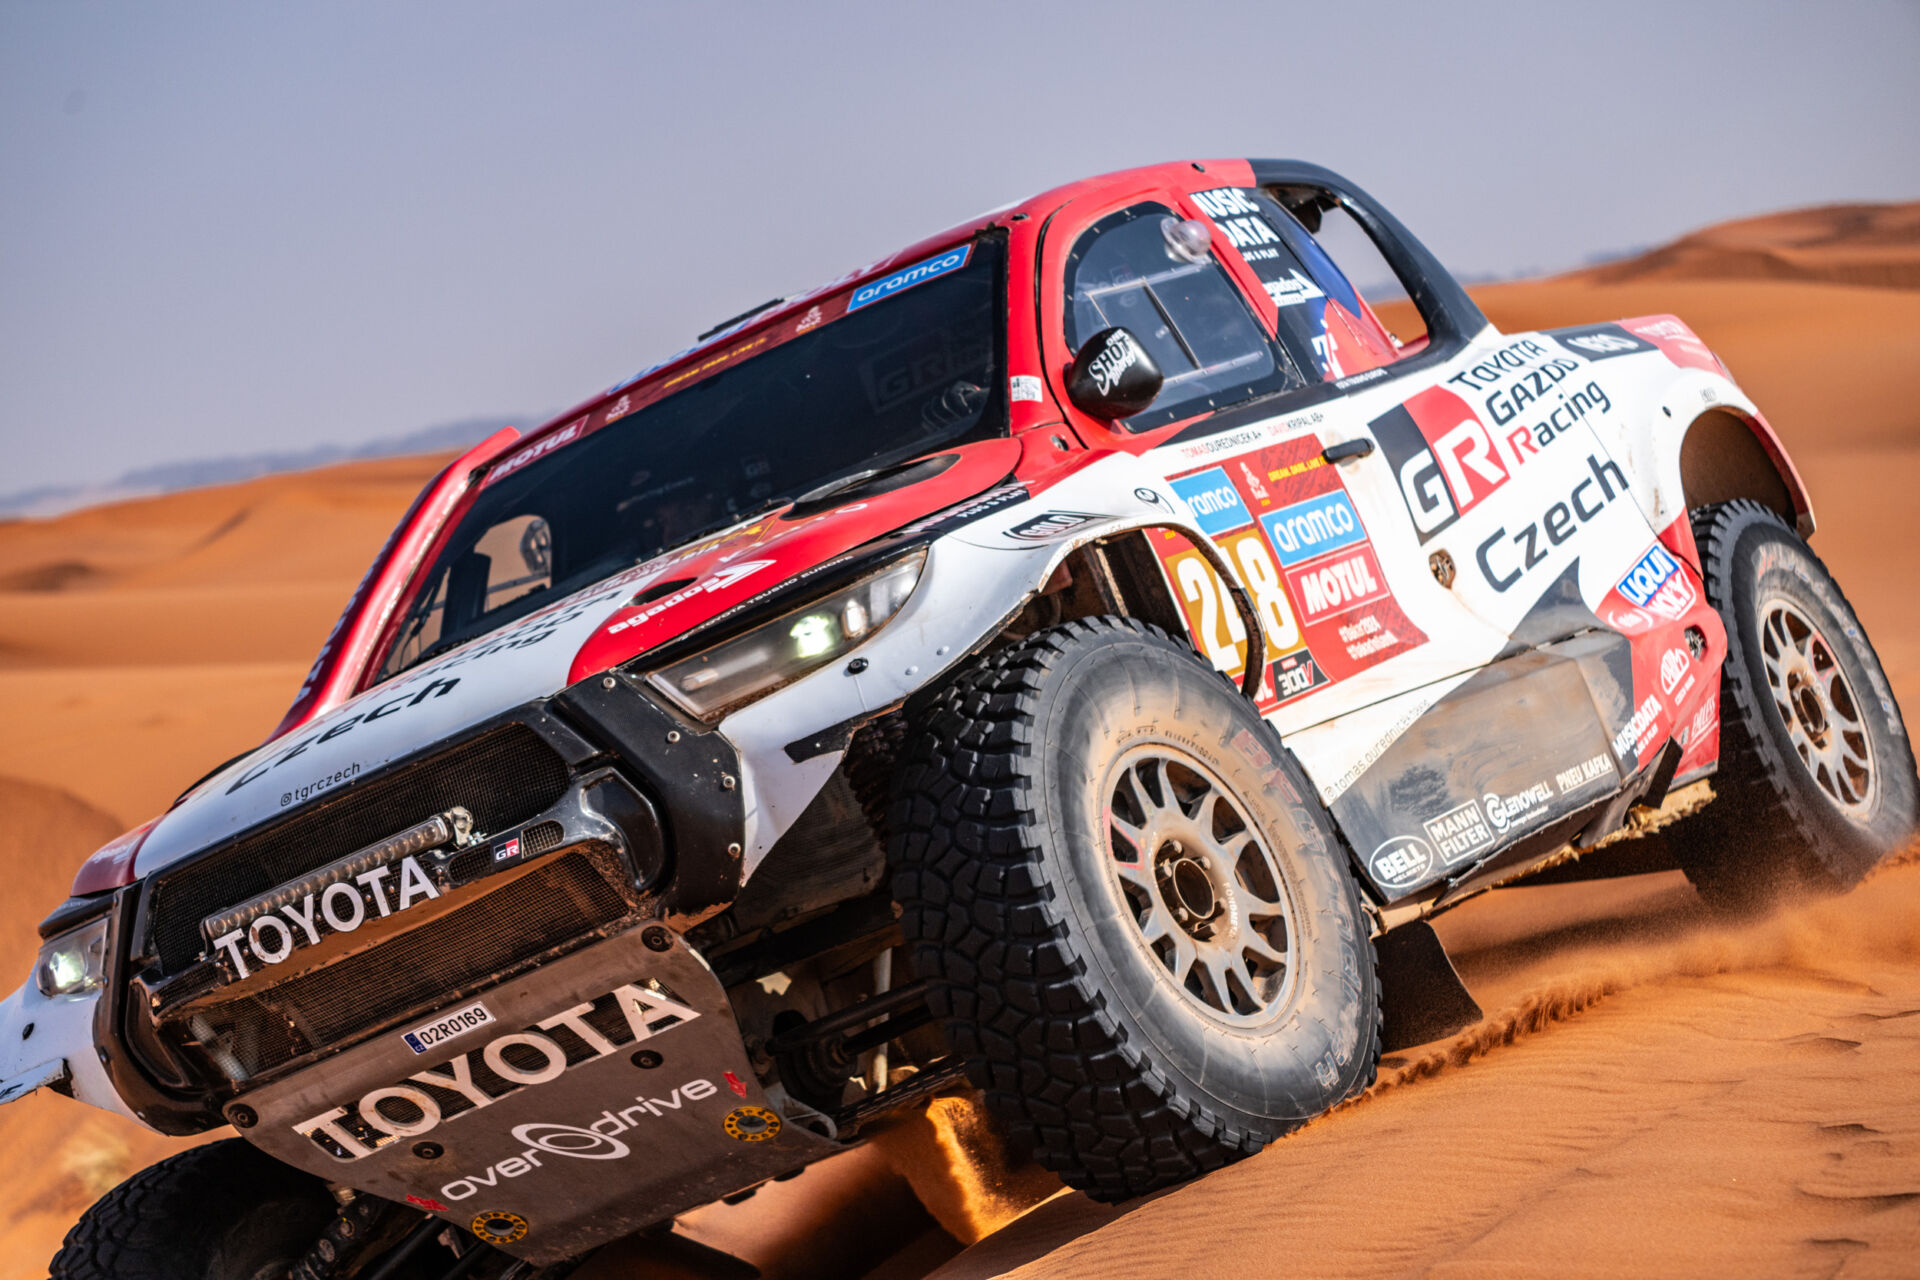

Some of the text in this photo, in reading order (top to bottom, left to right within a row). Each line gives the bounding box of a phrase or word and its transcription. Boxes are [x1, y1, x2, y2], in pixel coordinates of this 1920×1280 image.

[857, 254, 961, 302] aramco
[1088, 337, 1131, 396] SHOT
[1448, 339, 1548, 391] TOYOTA
[1485, 358, 1580, 426] GAZOO
[1507, 381, 1613, 466] Racing
[490, 425, 578, 481] MOTUL
[1399, 418, 1507, 534] GR
[1187, 486, 1238, 518] ramco
[1273, 502, 1355, 553] aramco
[1475, 454, 1630, 594] Czech
[747, 578, 799, 605] TSUSHO
[800, 555, 854, 579] EUROPE
[1300, 555, 1378, 615] MOTUL
[1620, 548, 1677, 606] LIQUI
[608, 577, 720, 636] agados
[1279, 660, 1313, 697] 300V
[1612, 694, 1662, 760] MUSICDATA
[1555, 765, 1584, 792] PNEU
[495, 842, 521, 861] GR
[1430, 805, 1481, 842] MANN
[1439, 824, 1491, 860] FILTER
[1375, 843, 1428, 881] BELL
[213, 857, 442, 979] TOYOTA
[292, 981, 702, 1161] TOYOTA
